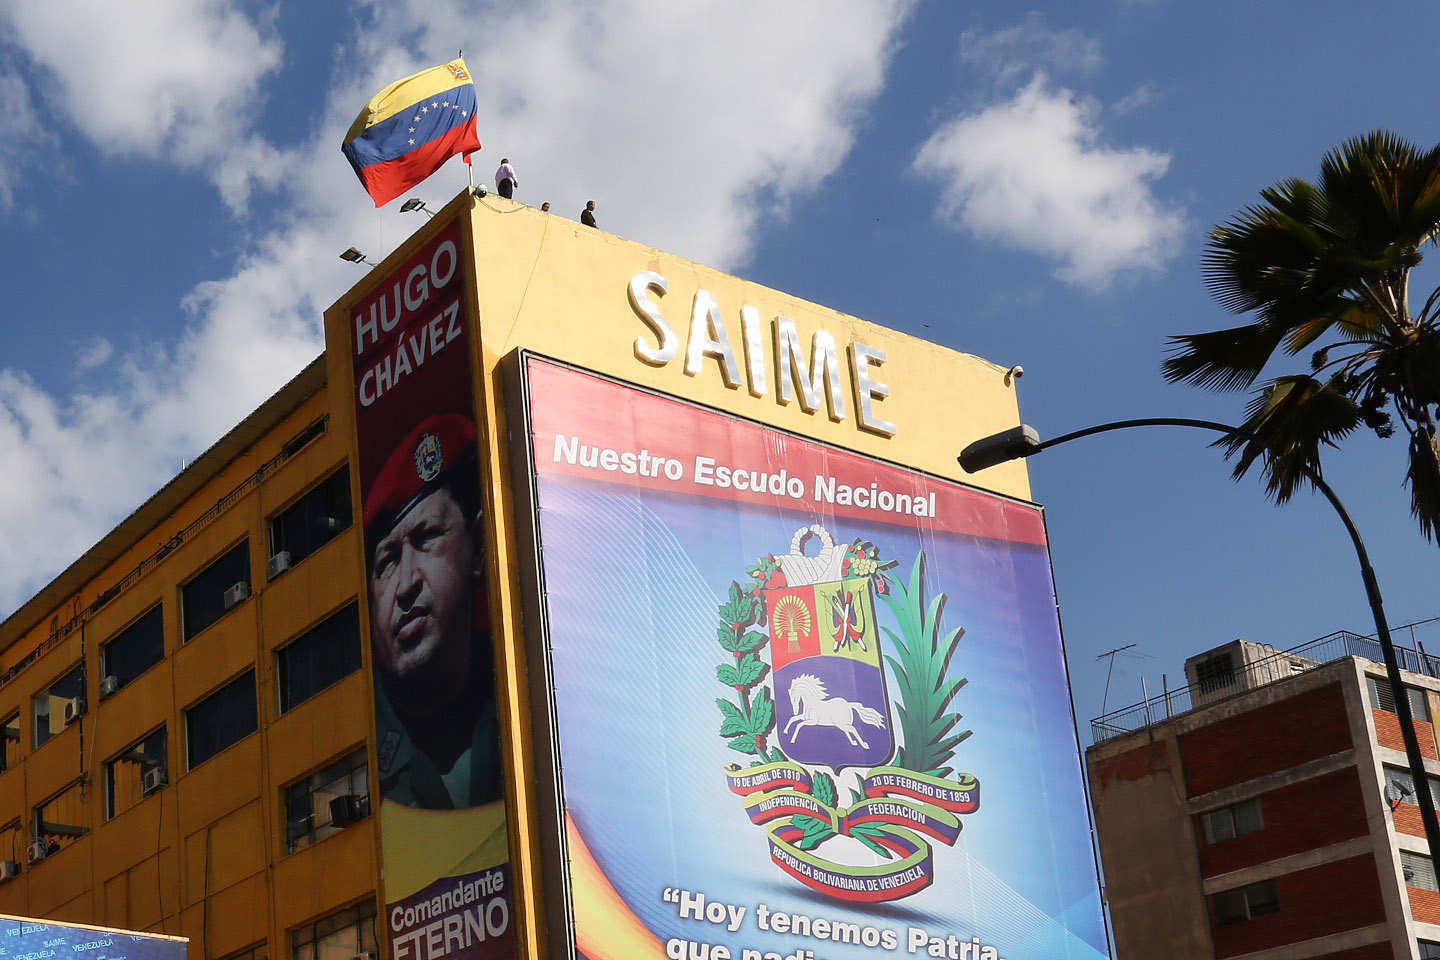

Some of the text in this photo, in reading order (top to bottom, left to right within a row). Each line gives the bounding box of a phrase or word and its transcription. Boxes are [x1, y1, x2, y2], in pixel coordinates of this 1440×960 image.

[356, 239, 457, 355] HUGO
[358, 300, 462, 407] CHÁVEZ
[627, 270, 897, 438] SAIME
[553, 433, 937, 518] Nuestro Escudo Nacional
[733, 769, 801, 787] 19 DE ABRIL DE 1810
[872, 775, 970, 803] 20 DE FEBRERO DE 1859
[759, 796, 819, 813] INDEPENDENCIA
[868, 803, 926, 824] FEDERACION
[772, 845, 925, 891] REPUBLICA BOLIVARIANA DE VENEZUELA
[391, 871, 504, 932] Comandante
[662, 887, 747, 932] “Hoy
[756, 904, 898, 950] tenemos
[43, 937, 67, 948] SAIME
[72, 938, 114, 952] VENEZUELA
